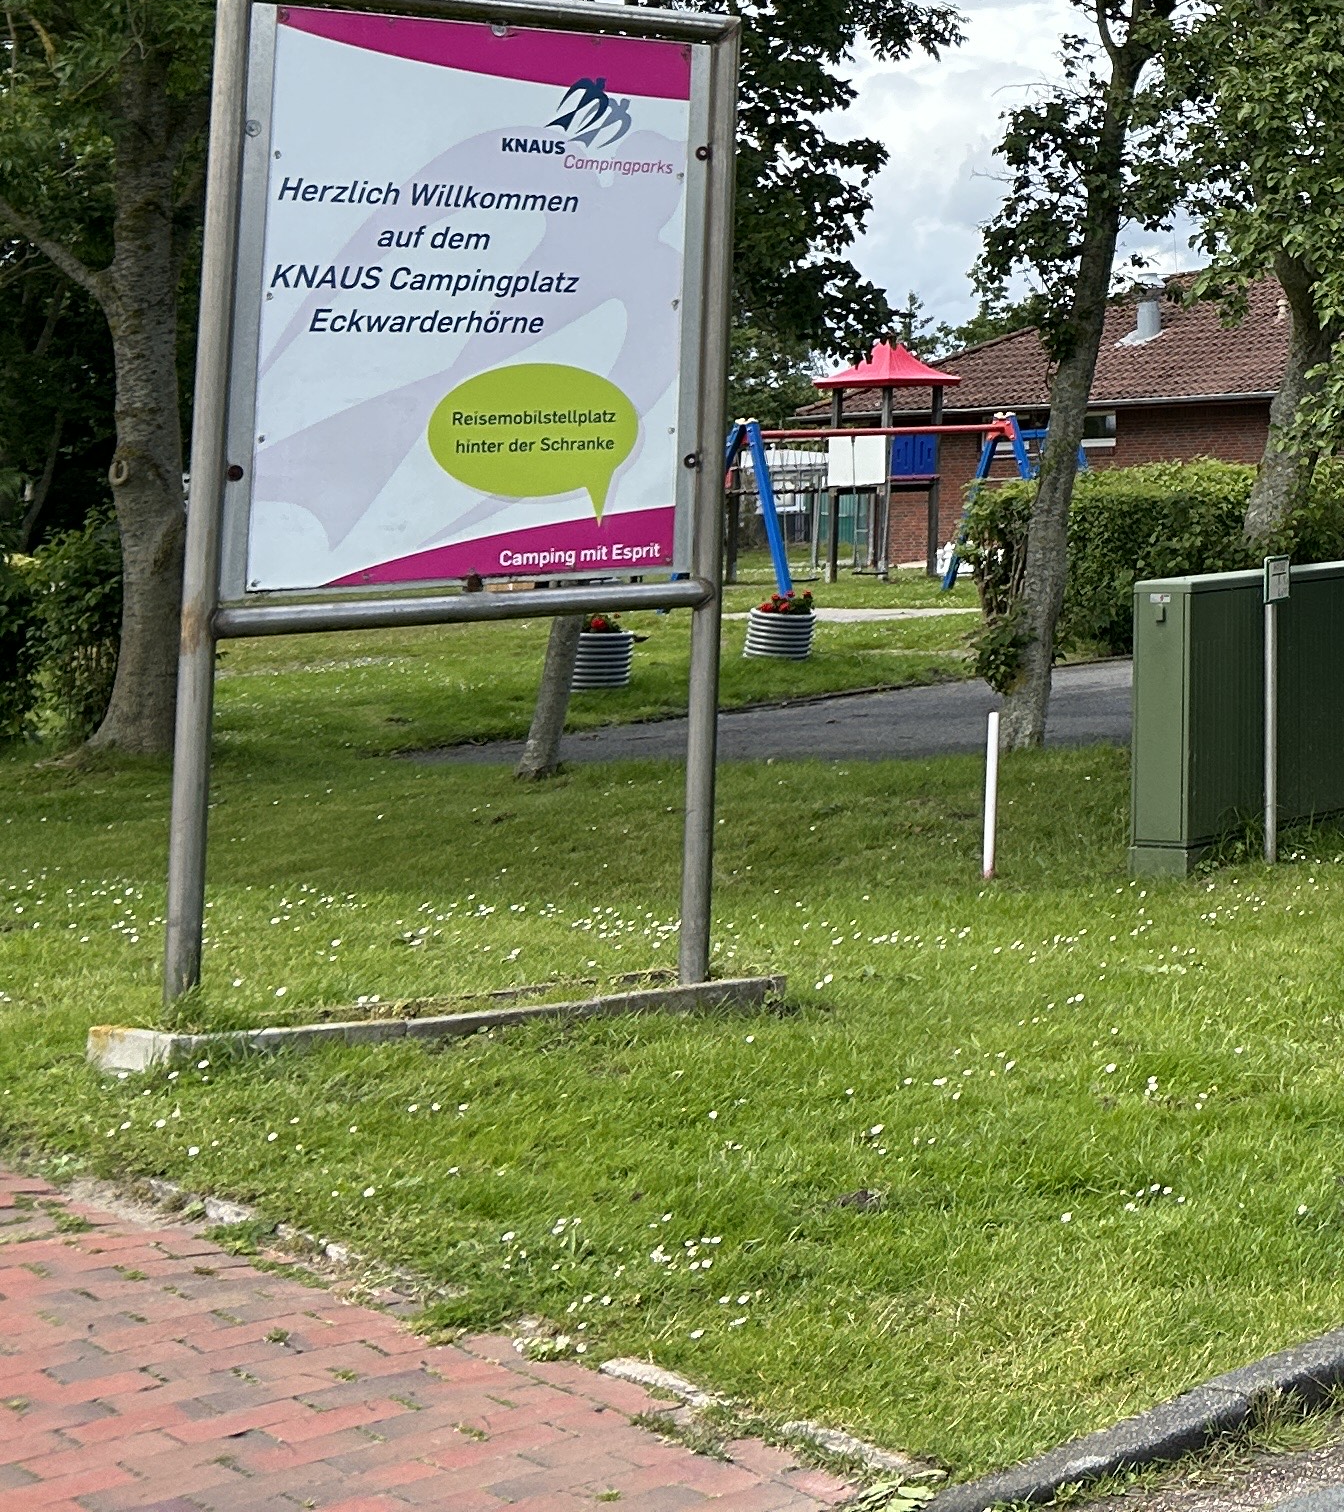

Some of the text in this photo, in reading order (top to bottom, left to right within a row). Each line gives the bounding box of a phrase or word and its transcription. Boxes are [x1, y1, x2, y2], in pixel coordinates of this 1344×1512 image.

[501, 137, 566, 155] KNAUS
[563, 154, 674, 176] Campingparks
[277, 177, 579, 213] Herzlich Willkommen
[377, 225, 490, 250] auf dem
[270, 264, 580, 298] KNAUS Campingplatz
[308, 308, 545, 334] Eckwarderhörne
[452, 409, 617, 427] Reisemobilstellplatz
[455, 437, 615, 454] hinter der Schranke
[499, 543, 661, 568] Camping mit Esprit
